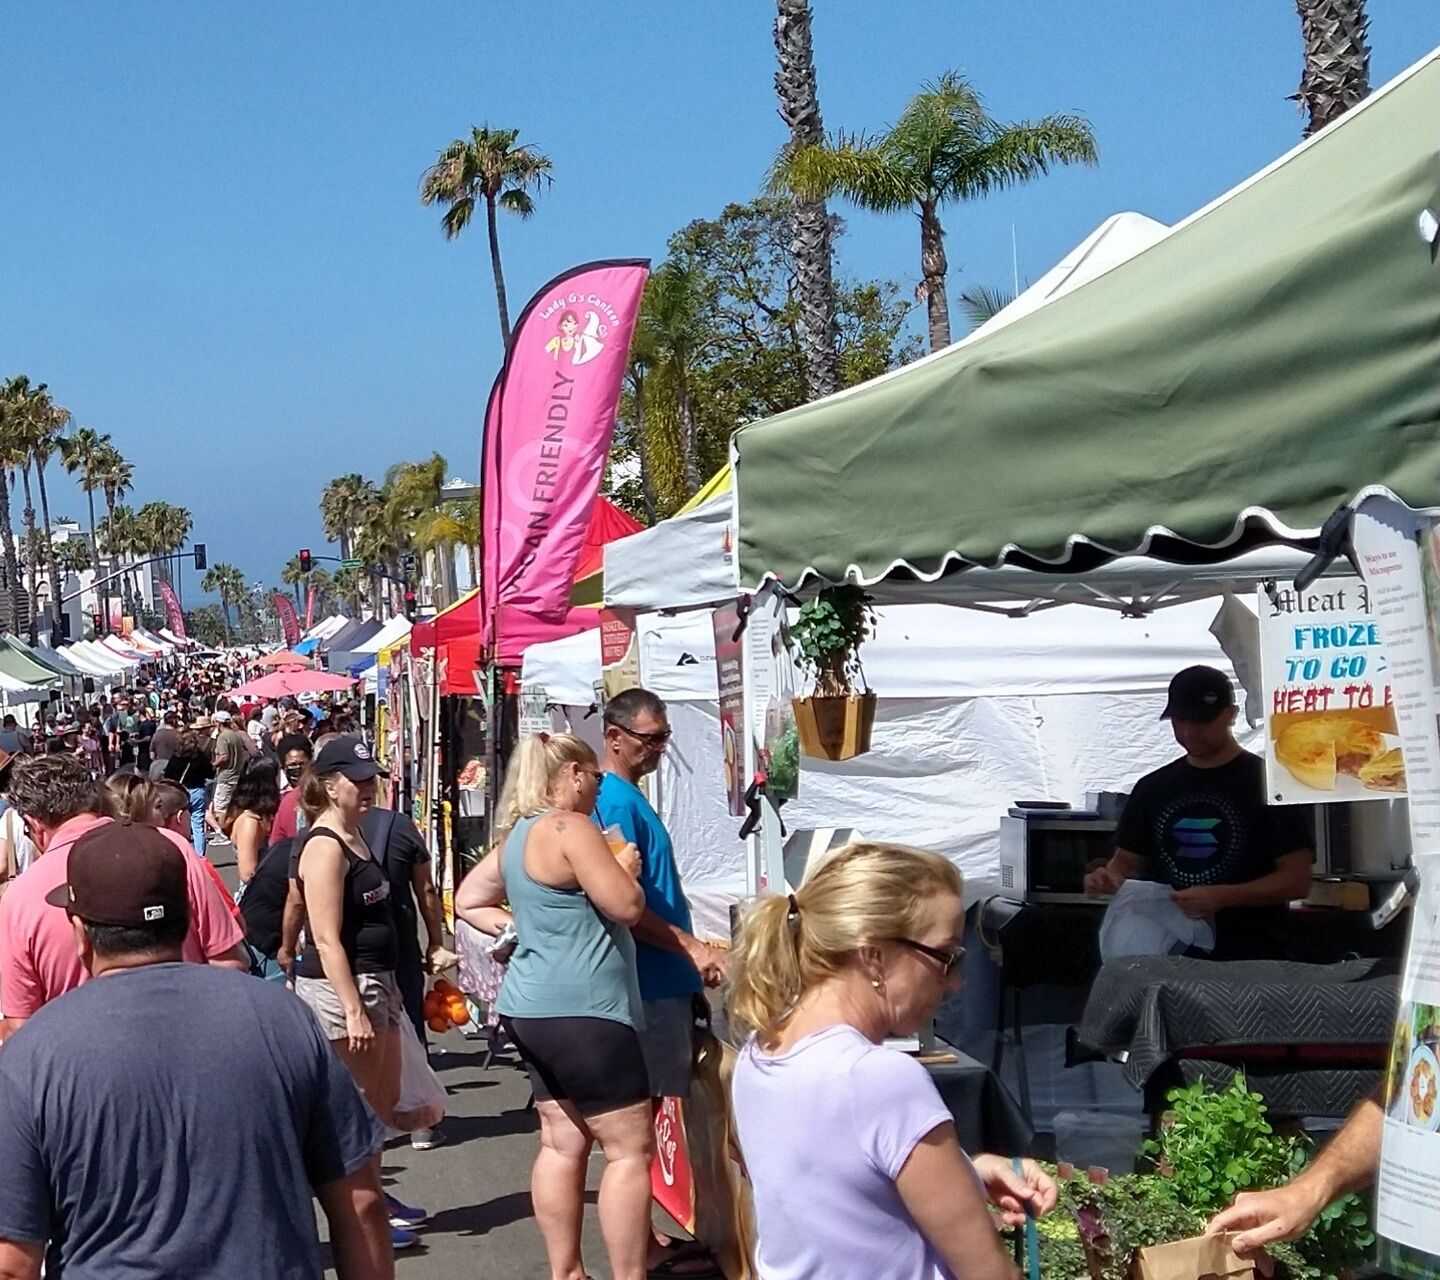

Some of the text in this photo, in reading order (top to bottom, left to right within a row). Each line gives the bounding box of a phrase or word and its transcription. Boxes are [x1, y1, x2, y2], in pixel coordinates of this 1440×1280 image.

[533, 371, 575, 504] FRIENDLY
[1270, 589, 1346, 618] Meat
[1294, 621, 1382, 651] FROZE
[1285, 653, 1367, 681] TO GO
[1273, 683, 1335, 714] HEAT
[1343, 681, 1374, 710] TO
